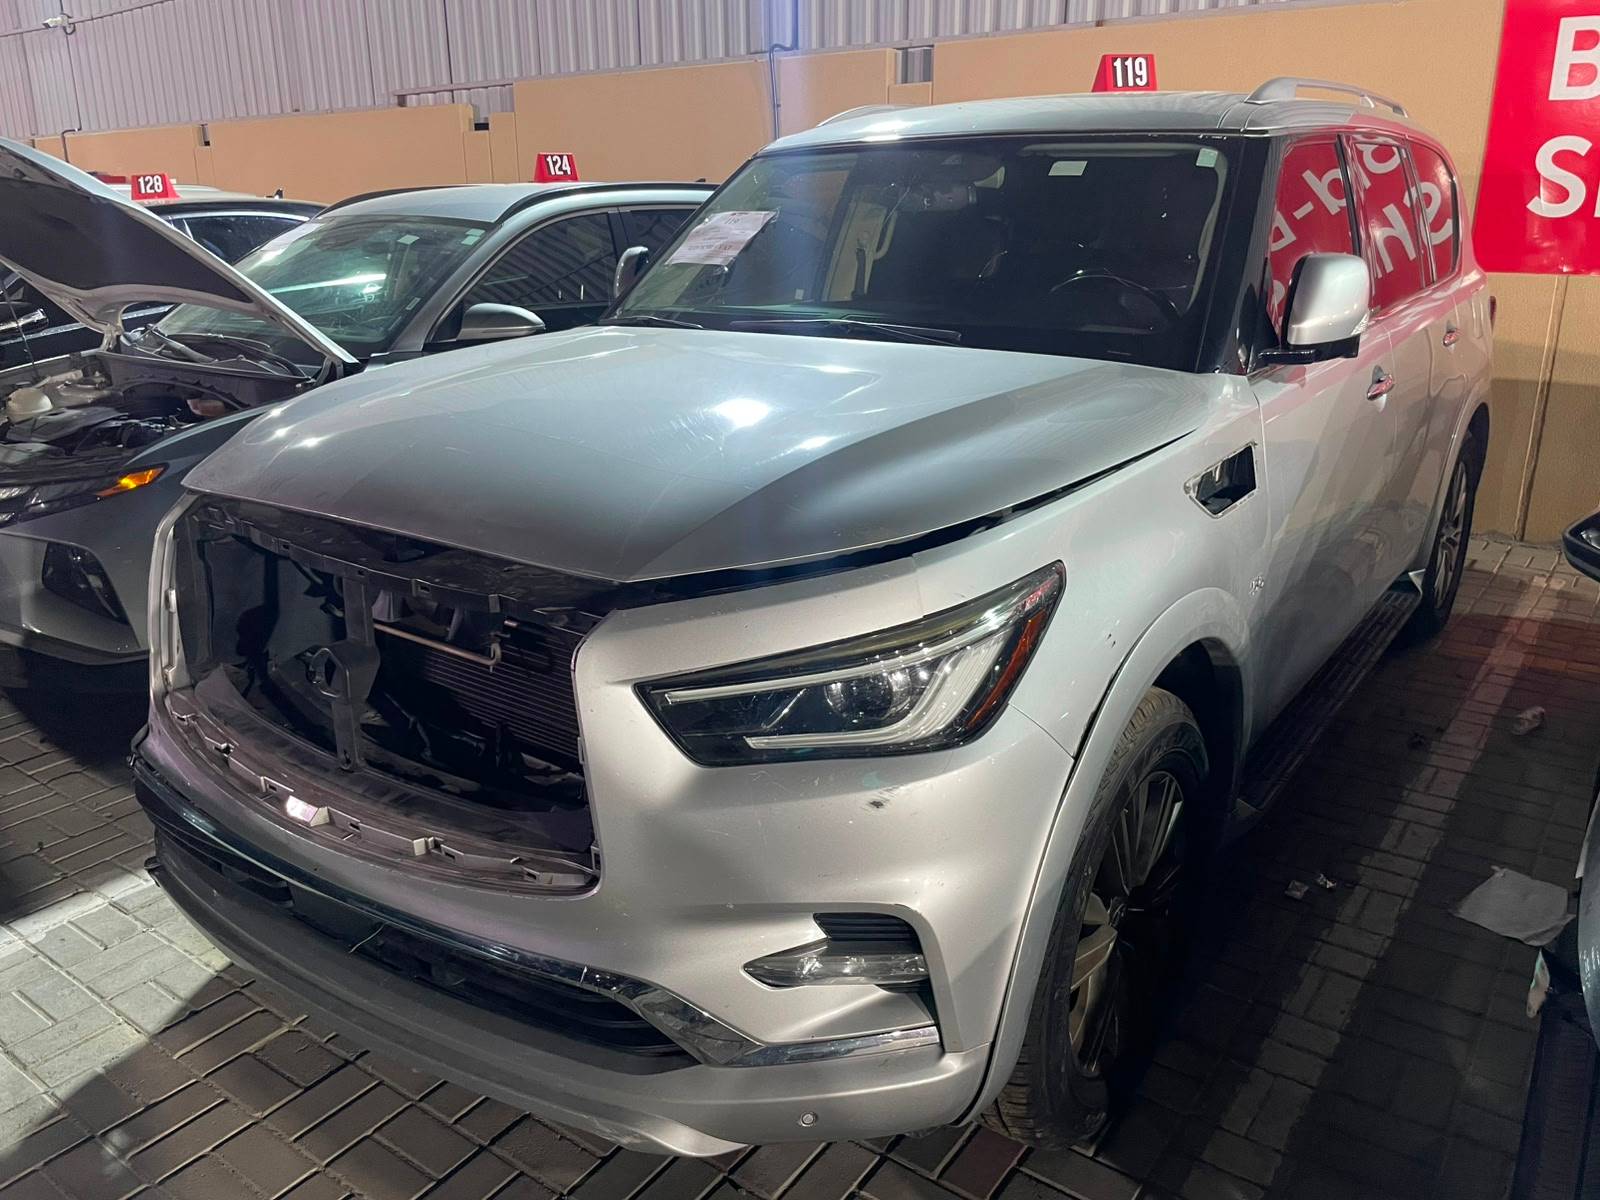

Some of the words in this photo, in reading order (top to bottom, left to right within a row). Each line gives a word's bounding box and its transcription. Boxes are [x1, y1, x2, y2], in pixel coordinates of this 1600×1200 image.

[1113, 57, 1148, 88] 119
[546, 155, 571, 175] 124
[1526, 135, 1600, 218] S
[138, 175, 163, 194] 128
